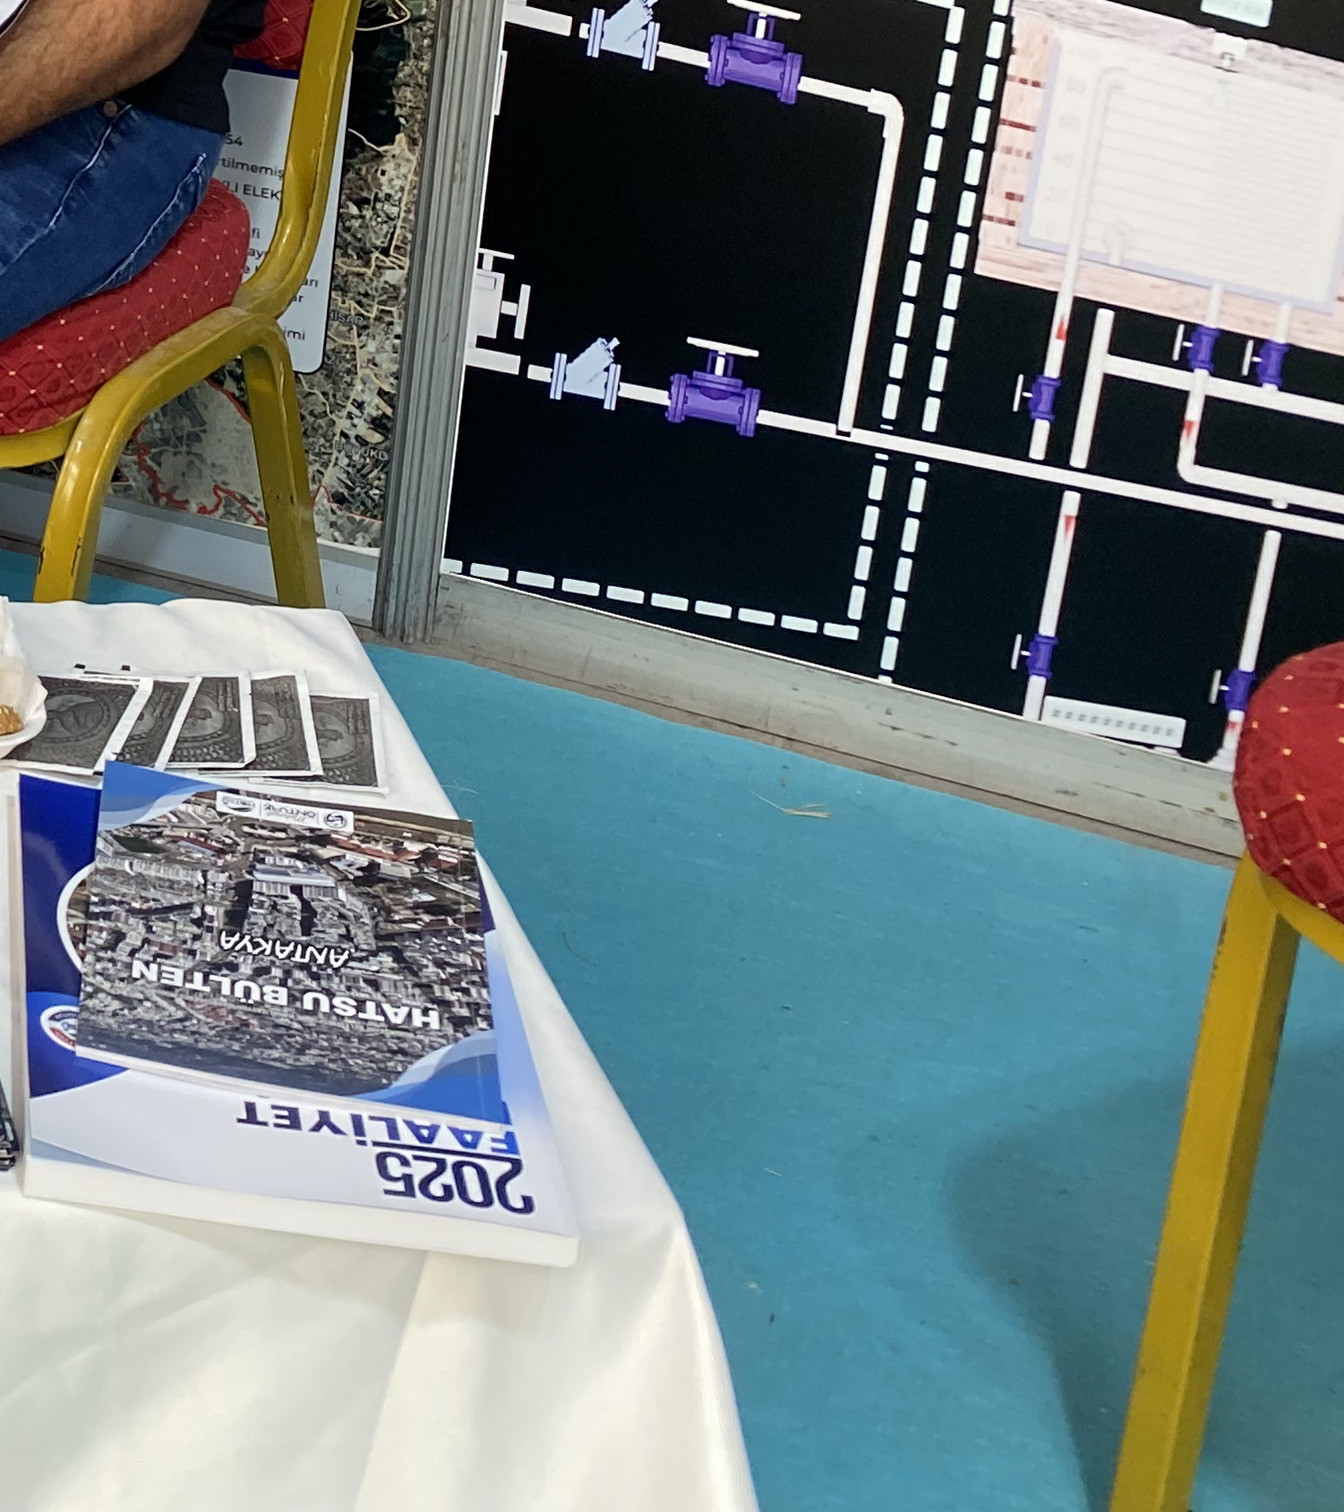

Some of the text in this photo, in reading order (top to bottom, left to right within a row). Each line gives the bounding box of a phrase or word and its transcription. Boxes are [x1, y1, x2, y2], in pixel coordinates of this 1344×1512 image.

[220, 930, 350, 969] ANTAKYA
[131, 959, 440, 1030] HATSU BÜLTEN
[236, 1100, 521, 1156] FAALİYET
[374, 1150, 536, 1216] 2025
